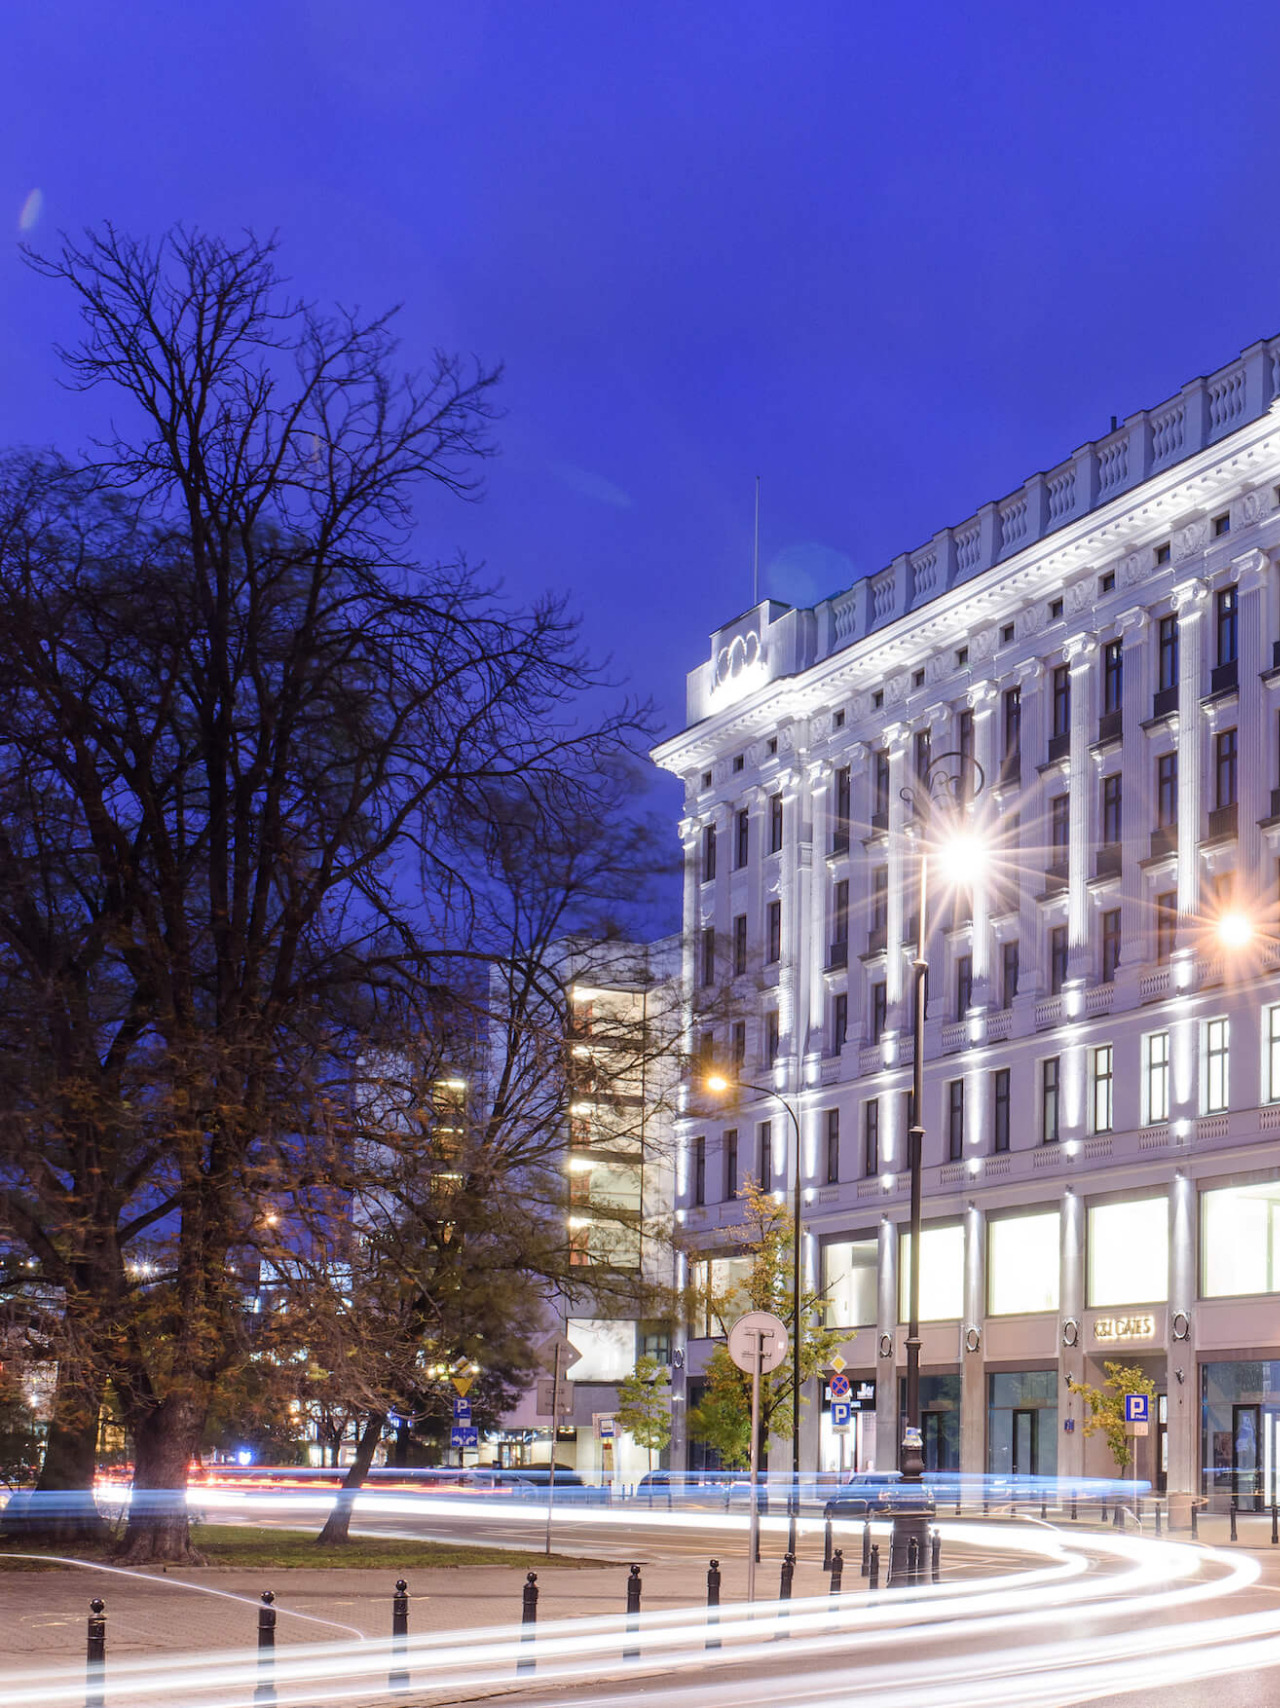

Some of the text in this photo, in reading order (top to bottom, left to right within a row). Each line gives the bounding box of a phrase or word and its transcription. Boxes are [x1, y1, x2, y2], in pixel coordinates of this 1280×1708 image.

[1115, 1318, 1151, 1336] GATES
[457, 1399, 468, 1413] P
[835, 1405, 847, 1423] P
[1130, 1397, 1145, 1419] P
